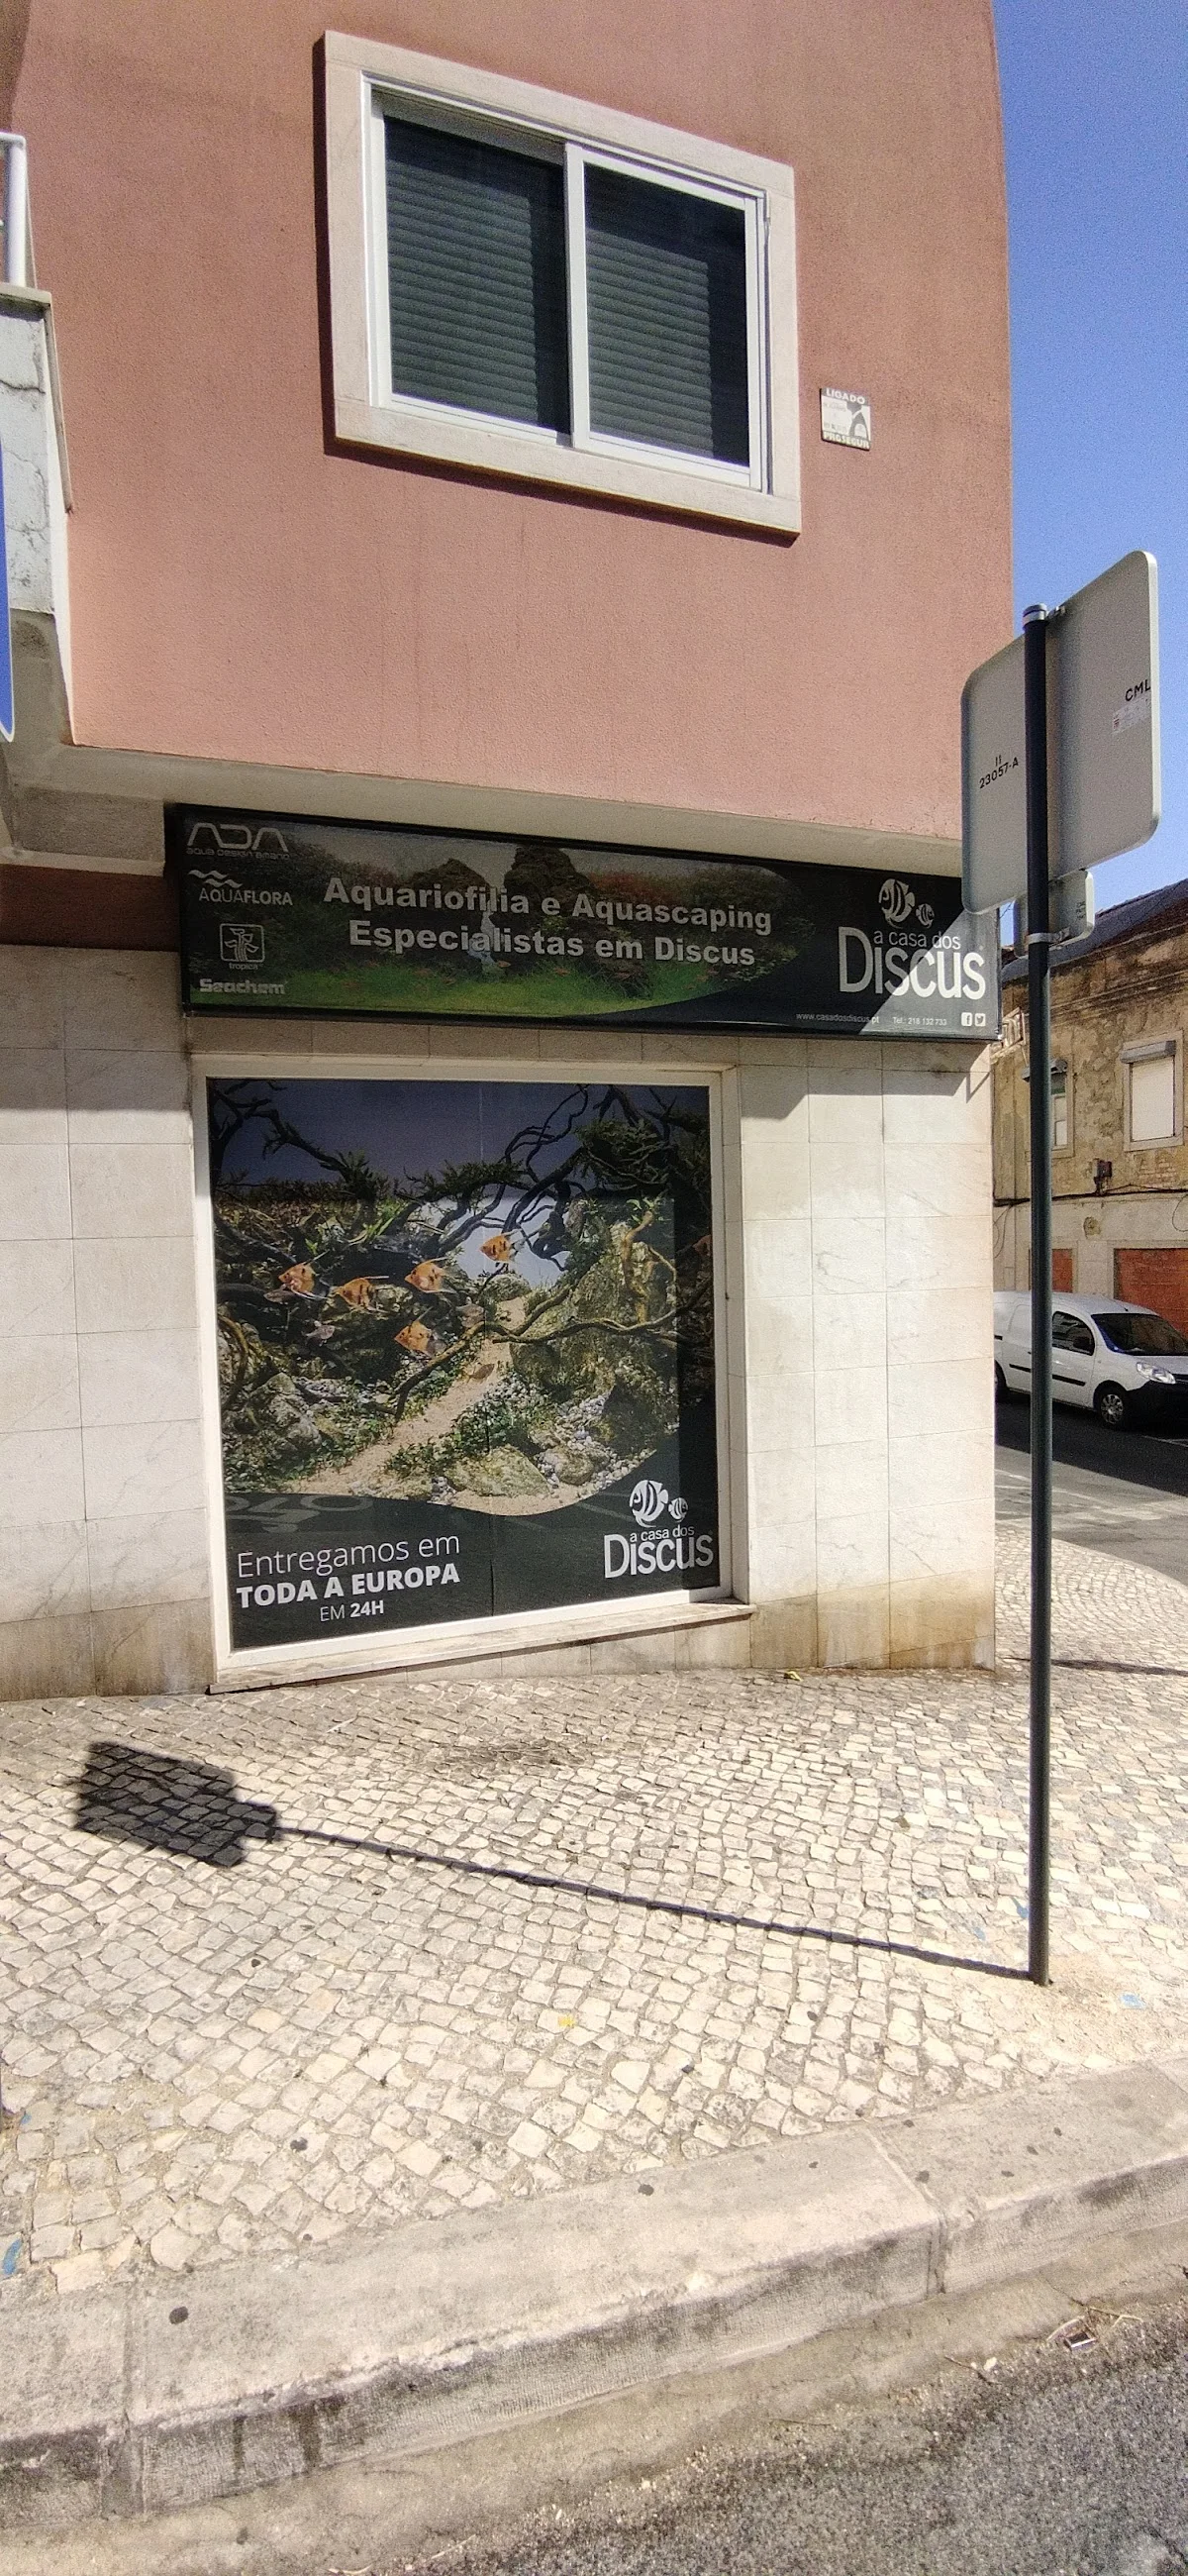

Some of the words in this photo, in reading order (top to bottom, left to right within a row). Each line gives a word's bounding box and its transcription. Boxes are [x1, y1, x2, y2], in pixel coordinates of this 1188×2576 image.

[1125, 679, 1151, 701] CML
[199, 887, 293, 906] AQUAFLORA
[323, 877, 530, 914] Aquariofilia
[541, 896, 561, 916] e
[571, 893, 772, 936] Aquascaping
[348, 919, 584, 957] Especialistas
[595, 939, 644, 960] em
[654, 936, 755, 966] Discus
[873, 930, 884, 945] a
[888, 931, 928, 948] casa
[932, 931, 961, 950] dos
[199, 978, 285, 994] Seachem
[629, 1532, 638, 1542] a
[641, 1528, 669, 1542] casa
[672, 1524, 695, 1538] dos
[238, 1541, 409, 1578] Entregamos
[418, 1535, 460, 1558] em
[236, 1580, 318, 1609] TODA
[324, 1577, 345, 1598] A
[351, 1563, 460, 1597] EUROPA
[320, 1604, 346, 1622] EM
[349, 1599, 384, 1618] 24H
